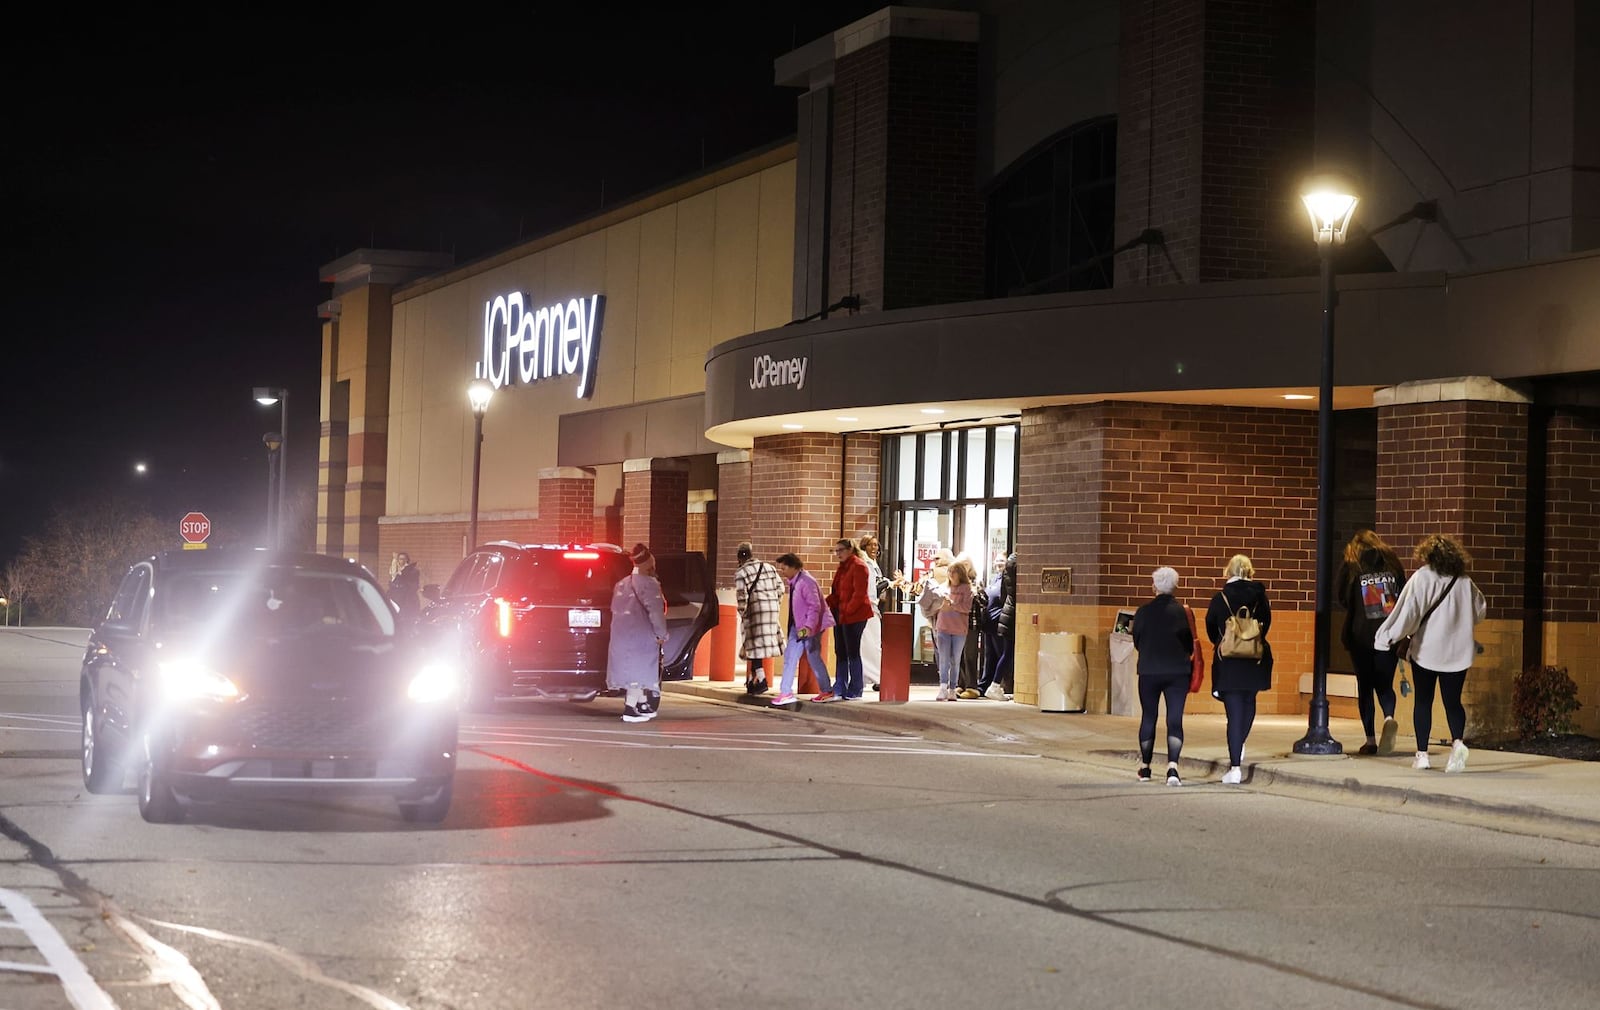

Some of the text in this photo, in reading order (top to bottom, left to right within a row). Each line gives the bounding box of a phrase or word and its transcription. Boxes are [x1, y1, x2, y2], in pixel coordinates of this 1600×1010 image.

[475, 291, 599, 399] JCPenney
[750, 355, 808, 390] JCPenney
[182, 522, 208, 534] STOP
[1360, 576, 1396, 587] OCEAN
